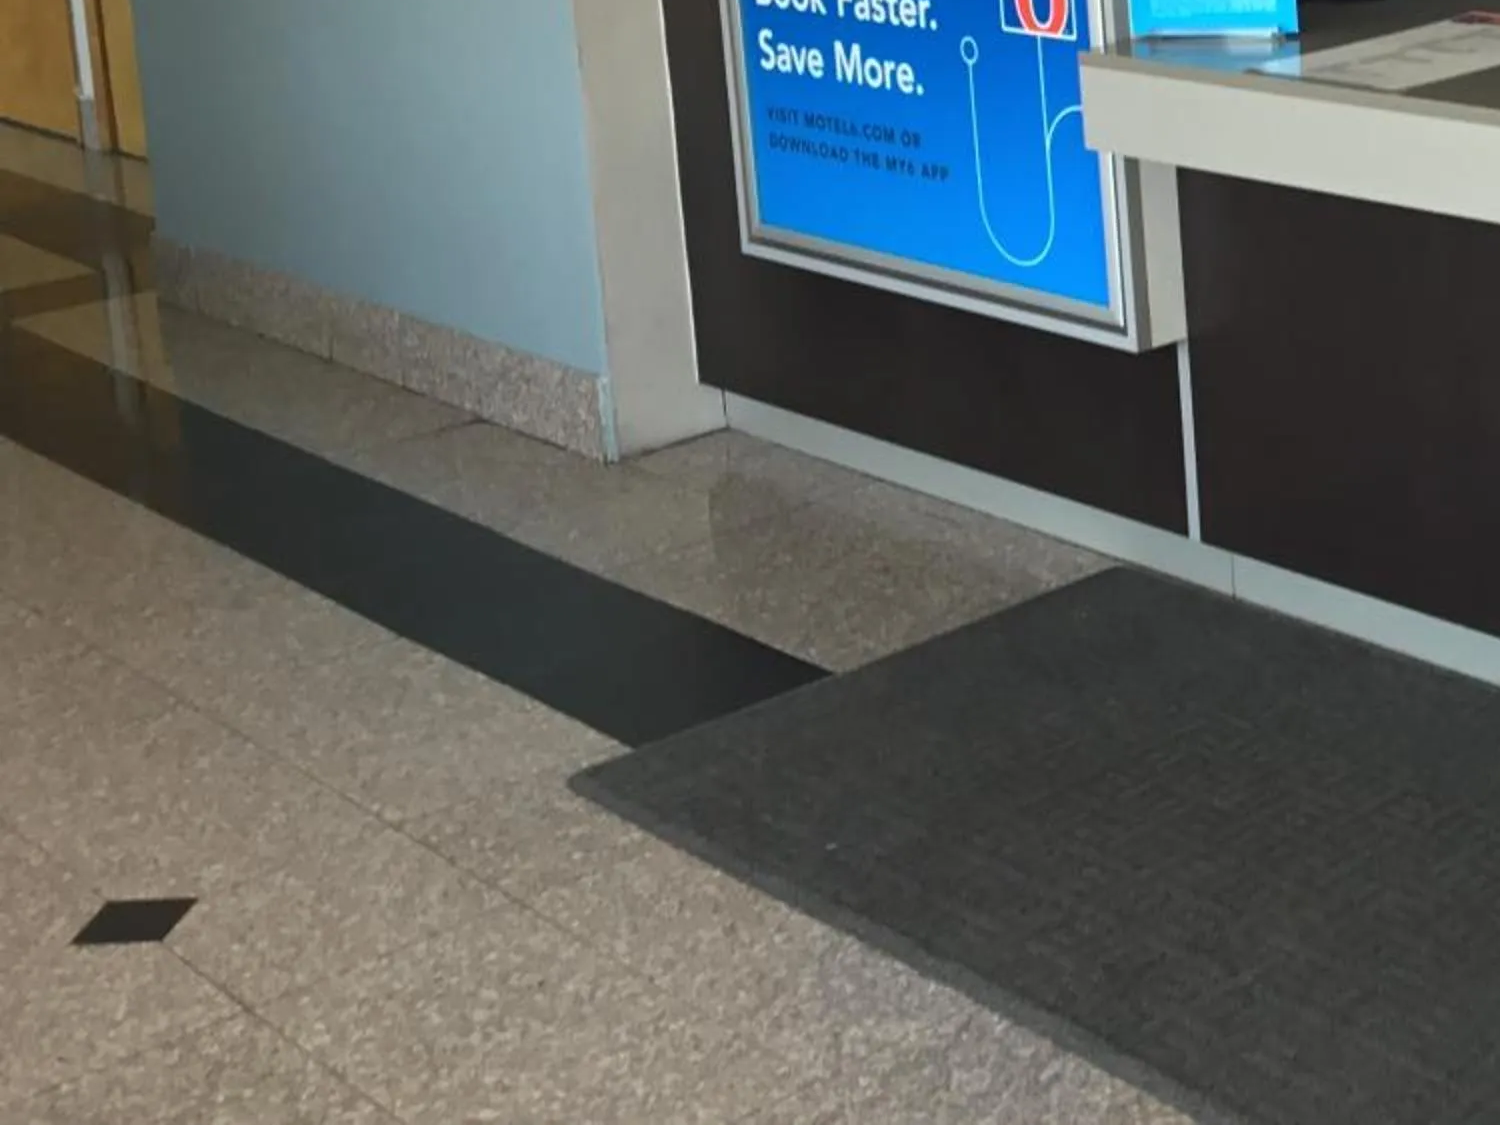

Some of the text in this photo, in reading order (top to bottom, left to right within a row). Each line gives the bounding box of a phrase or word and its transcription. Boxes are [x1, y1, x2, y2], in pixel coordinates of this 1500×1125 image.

[757, 28, 925, 96] Save More.
[768, 106, 921, 148] VISIT MOTEL6.COM OR
[769, 131, 950, 183] DOWNLOAD THE MY6 APP
